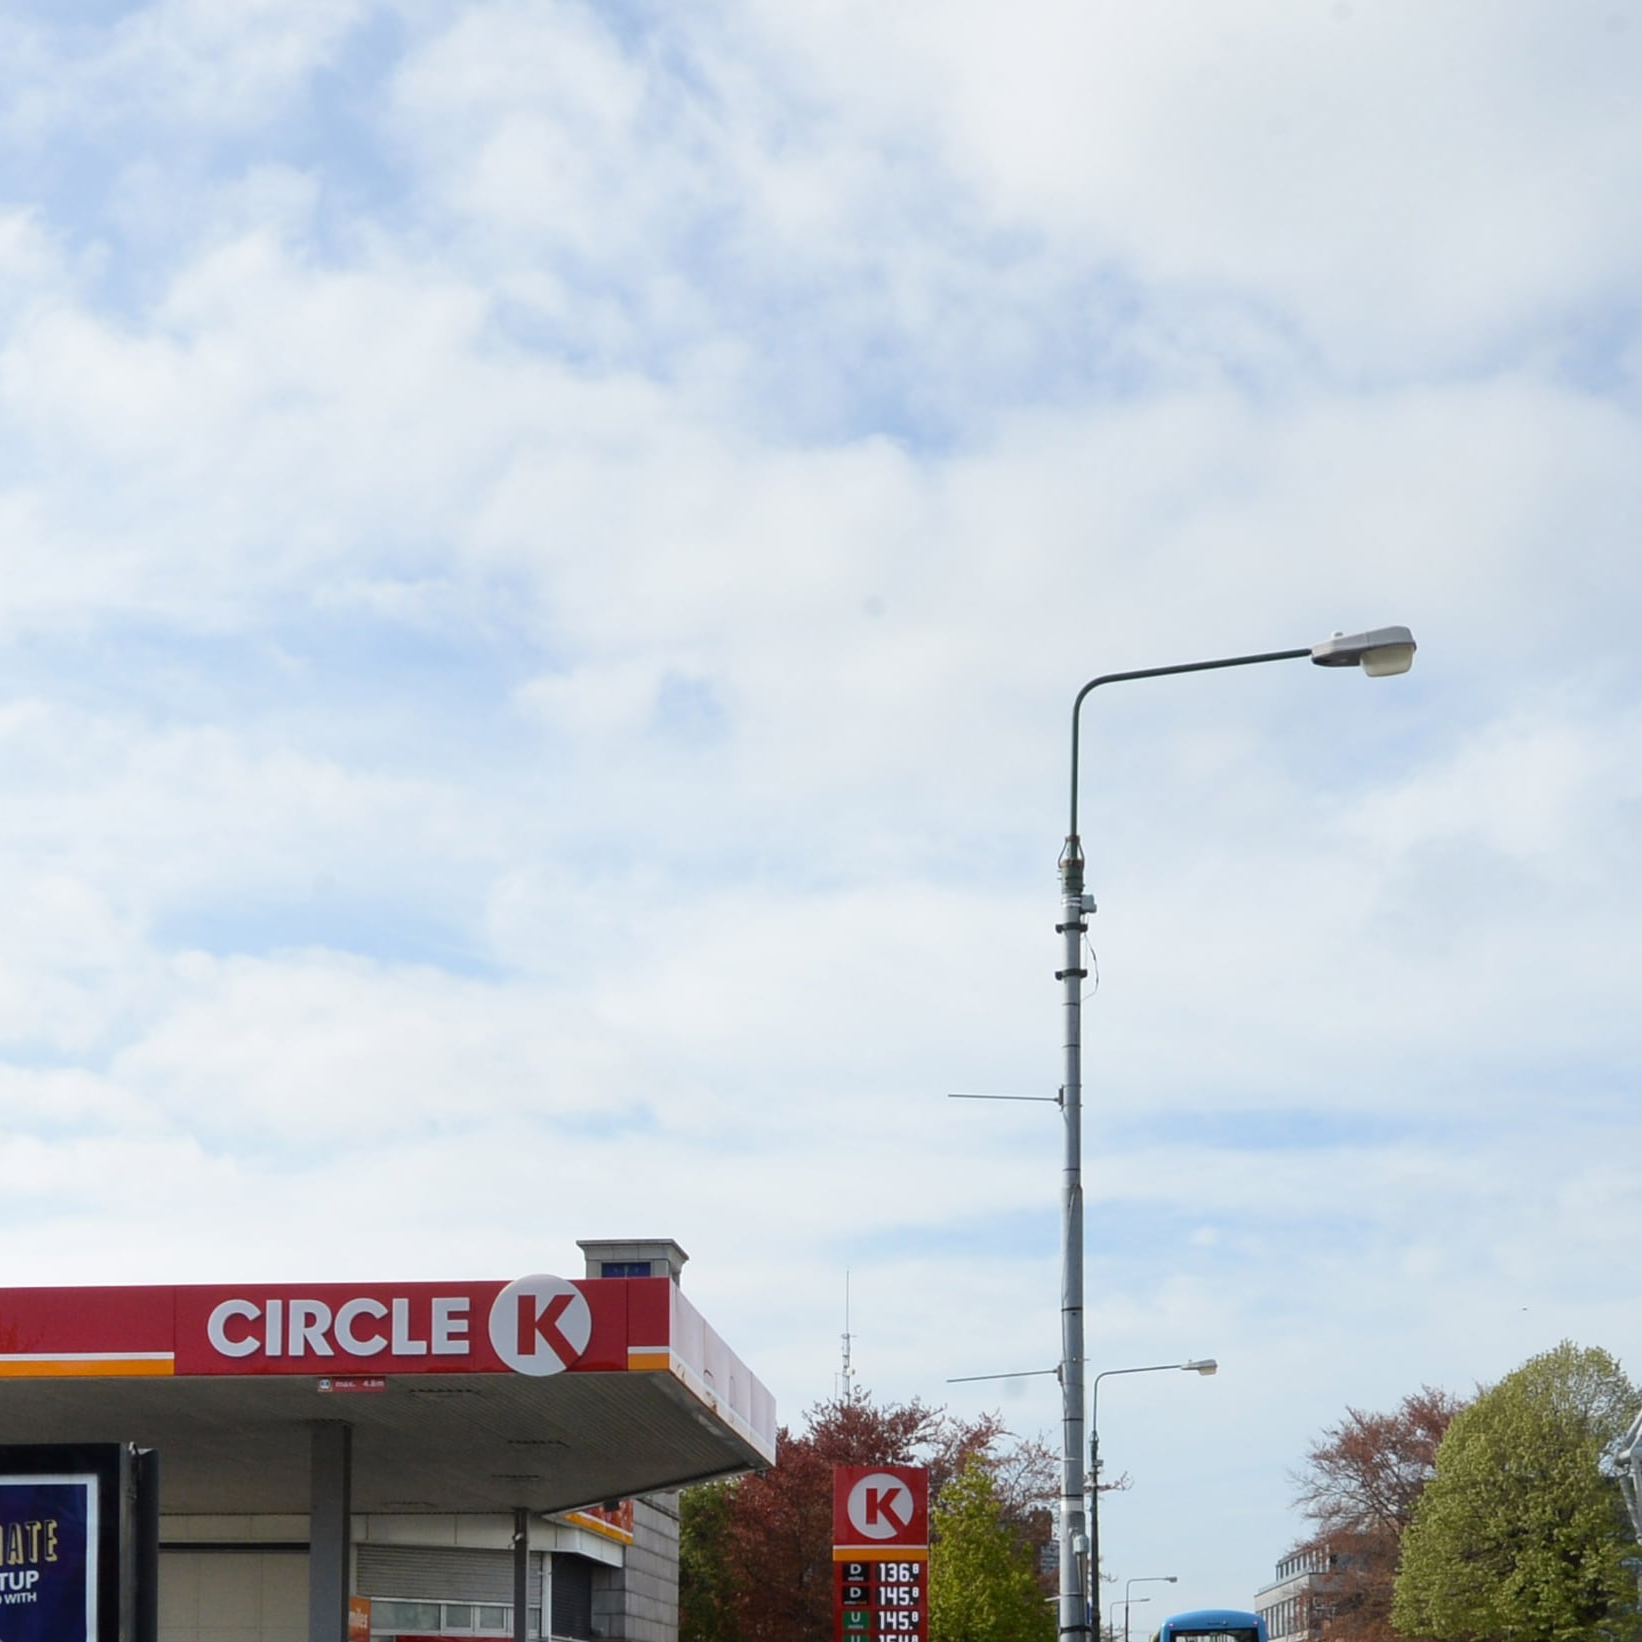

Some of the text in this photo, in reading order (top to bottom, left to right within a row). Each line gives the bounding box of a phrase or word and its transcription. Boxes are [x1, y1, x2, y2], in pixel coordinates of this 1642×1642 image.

[207, 1294, 581, 1369] CIRCLE K
[866, 1488, 908, 1535] K
[850, 1564, 861, 1574] D
[850, 1587, 861, 1597] D
[4, 1592, 37, 1604] WITH
[851, 1612, 861, 1622] U
